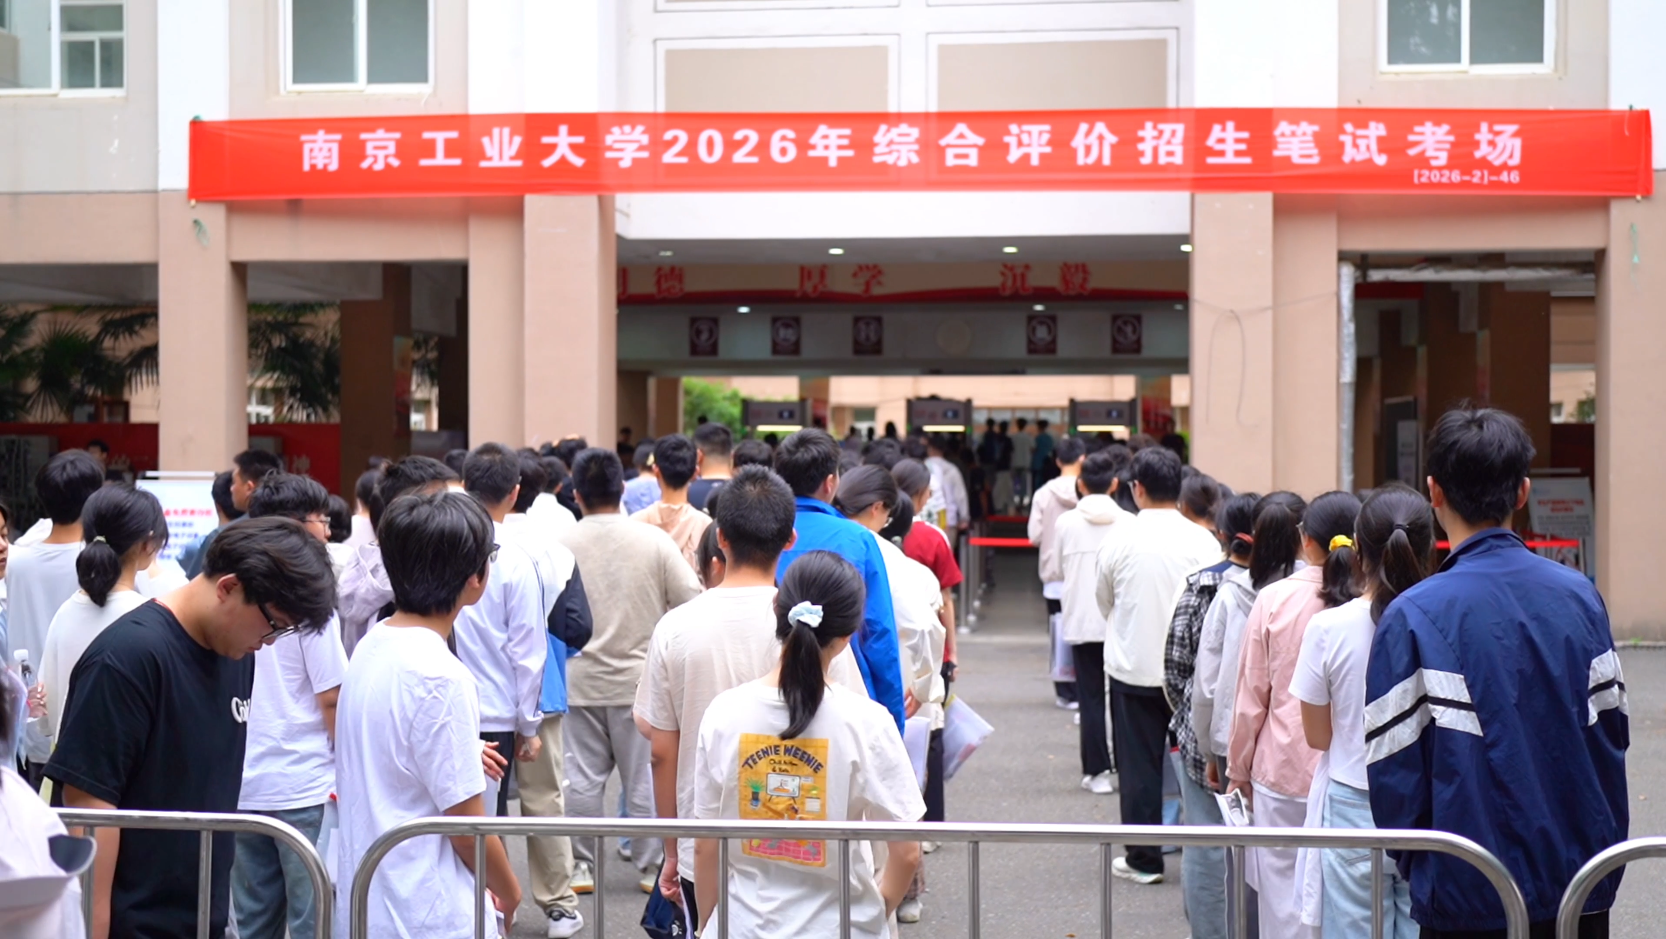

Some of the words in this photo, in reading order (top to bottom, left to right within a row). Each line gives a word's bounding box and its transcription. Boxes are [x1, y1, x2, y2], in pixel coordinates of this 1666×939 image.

[300, 120, 1522, 171] 南京工业大学2026年综合评价招生笔试考场
[797, 264, 885, 297] 厚学
[742, 745, 780, 769] TEENIE
[783, 745, 824, 774] WEENIE
